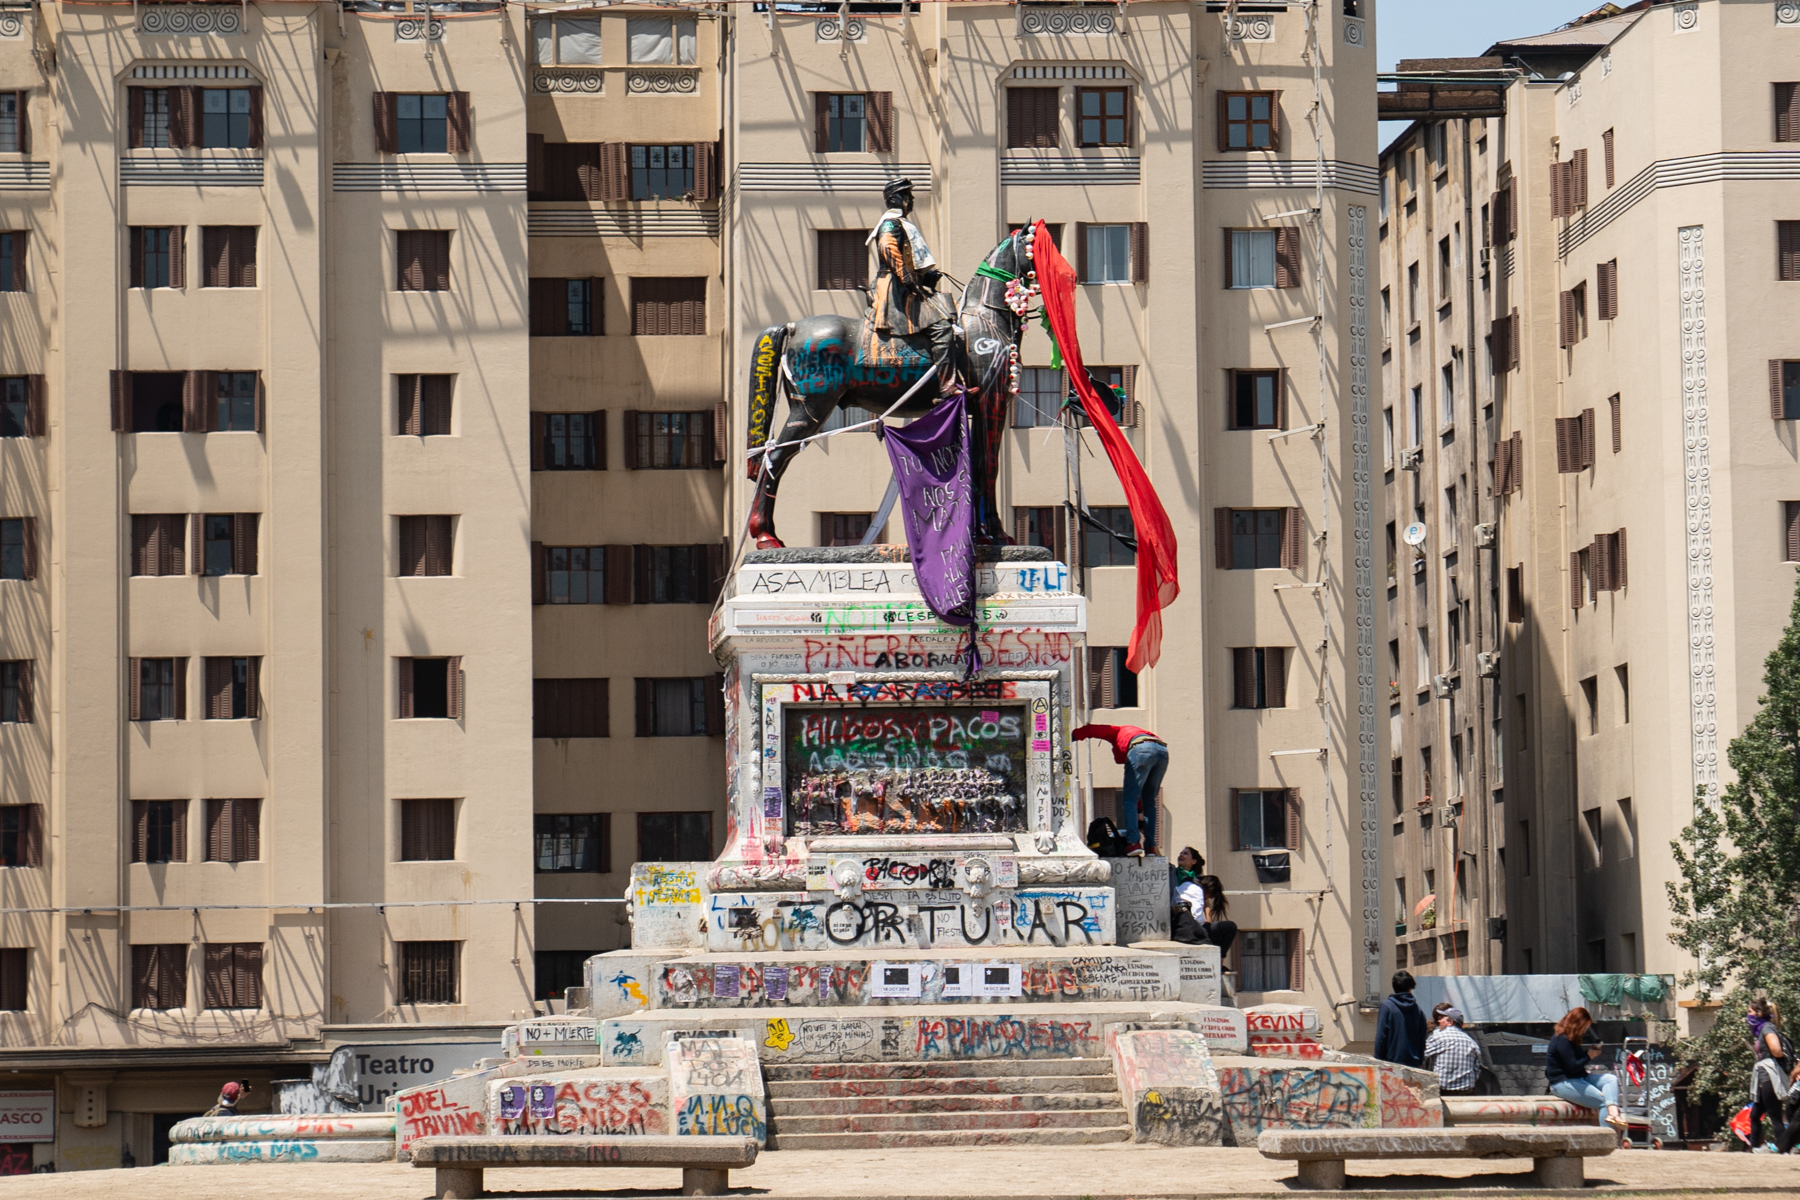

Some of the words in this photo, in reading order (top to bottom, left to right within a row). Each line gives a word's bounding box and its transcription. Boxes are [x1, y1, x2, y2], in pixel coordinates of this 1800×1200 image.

[751, 569, 892, 594] ASAMBLEA
[930, 714, 1021, 743] PACOS
[1072, 956, 1113, 966] CAMILO
[1247, 1012, 1305, 1032] KEVIN
[526, 1027, 541, 1041] NO
[554, 1027, 594, 1041] MUERTE
[355, 1054, 434, 1075] Teatro
[399, 1088, 457, 1117] JOEL
